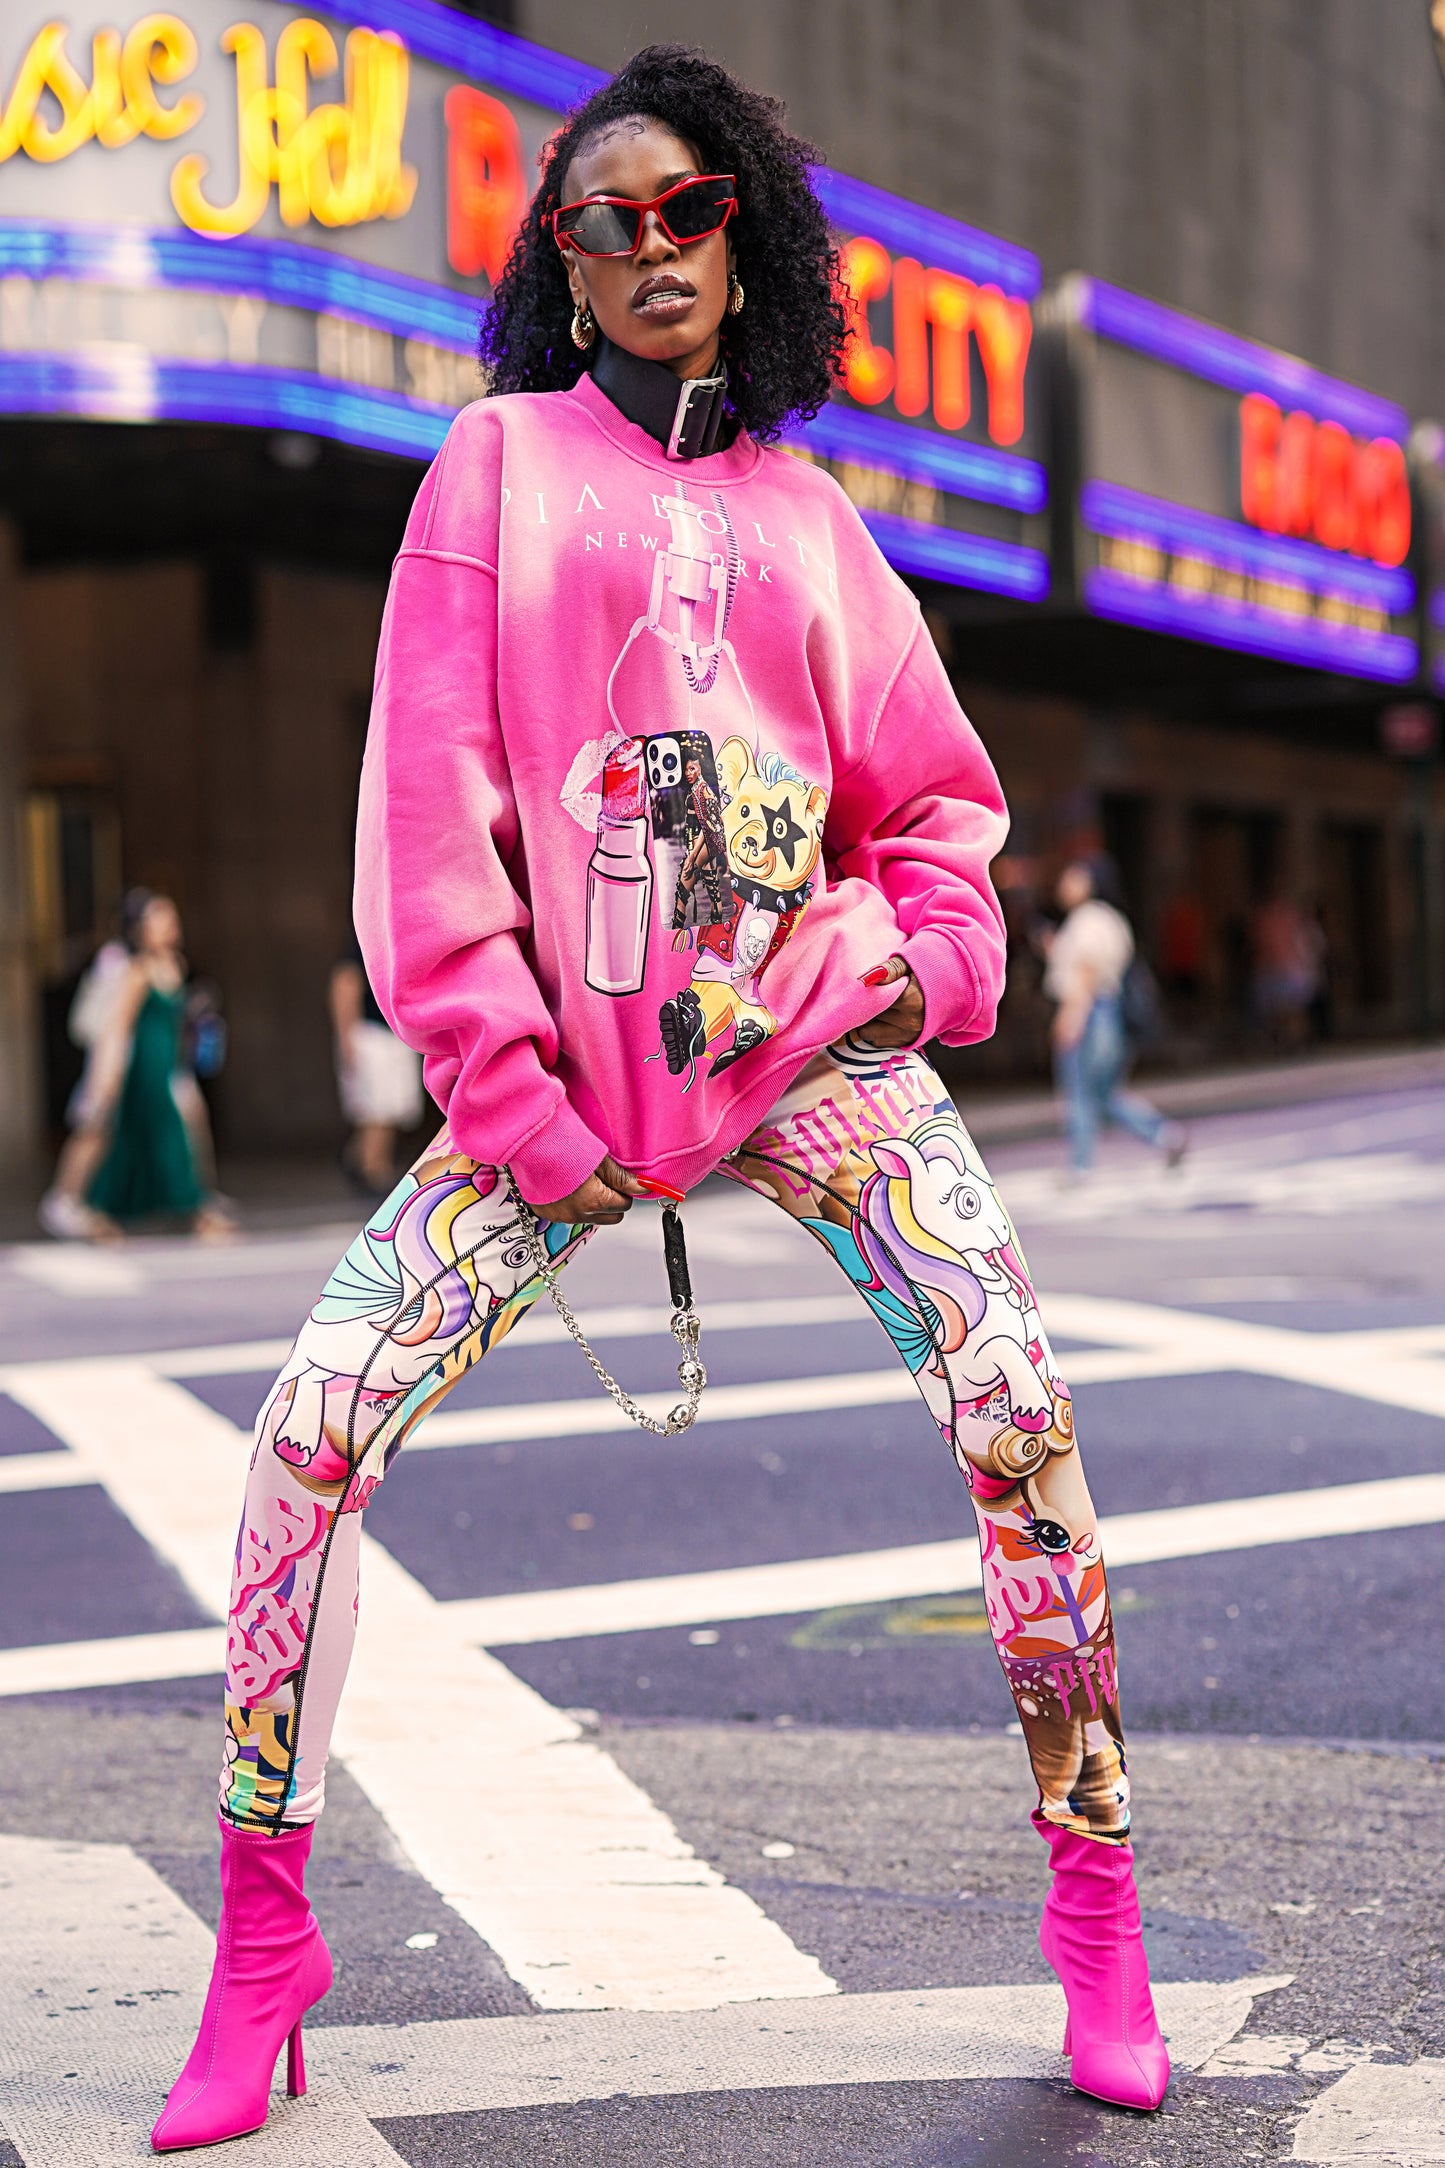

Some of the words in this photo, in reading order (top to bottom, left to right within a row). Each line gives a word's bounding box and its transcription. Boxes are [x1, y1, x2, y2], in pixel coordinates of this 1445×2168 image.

[835, 236, 1034, 447] CITY
[585, 531, 659, 551] NEW
[688, 546, 774, 584] YORK
